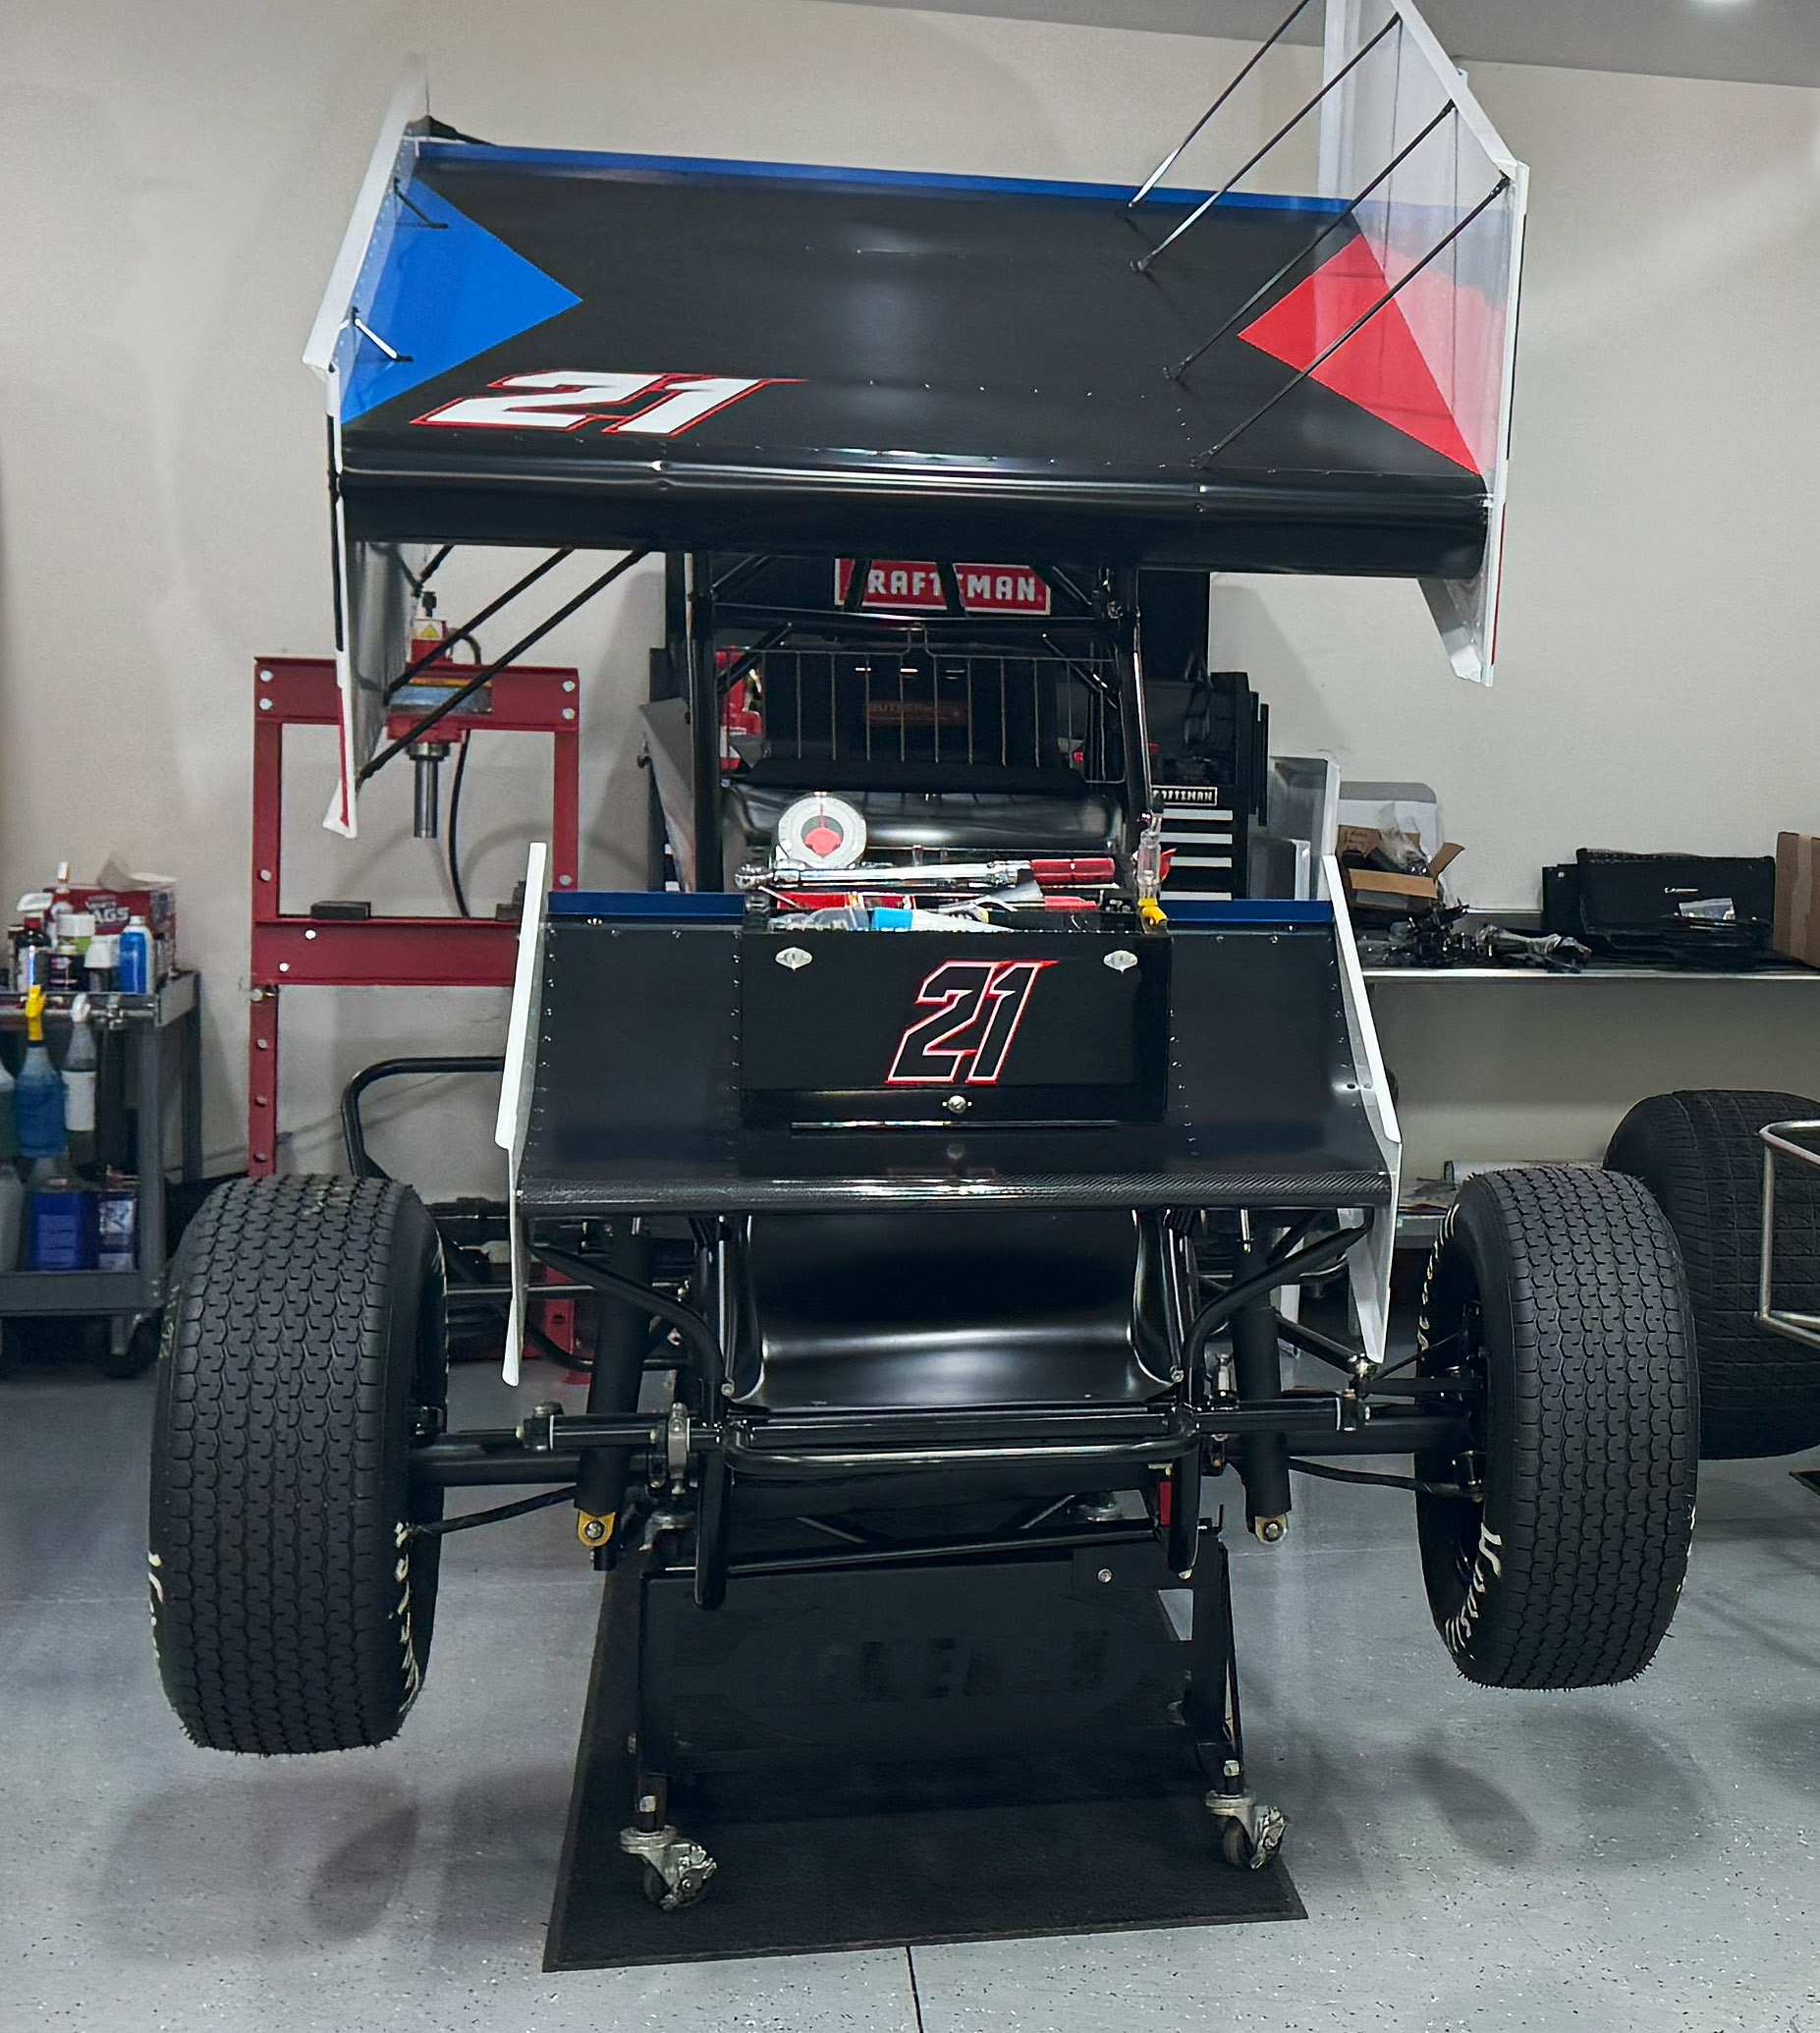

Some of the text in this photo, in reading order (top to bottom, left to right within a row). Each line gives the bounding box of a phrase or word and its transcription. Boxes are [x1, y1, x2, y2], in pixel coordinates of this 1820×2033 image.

[410, 368, 809, 437] 21
[864, 569, 1036, 603] RAFTMAN
[885, 960, 1060, 1085] 21
